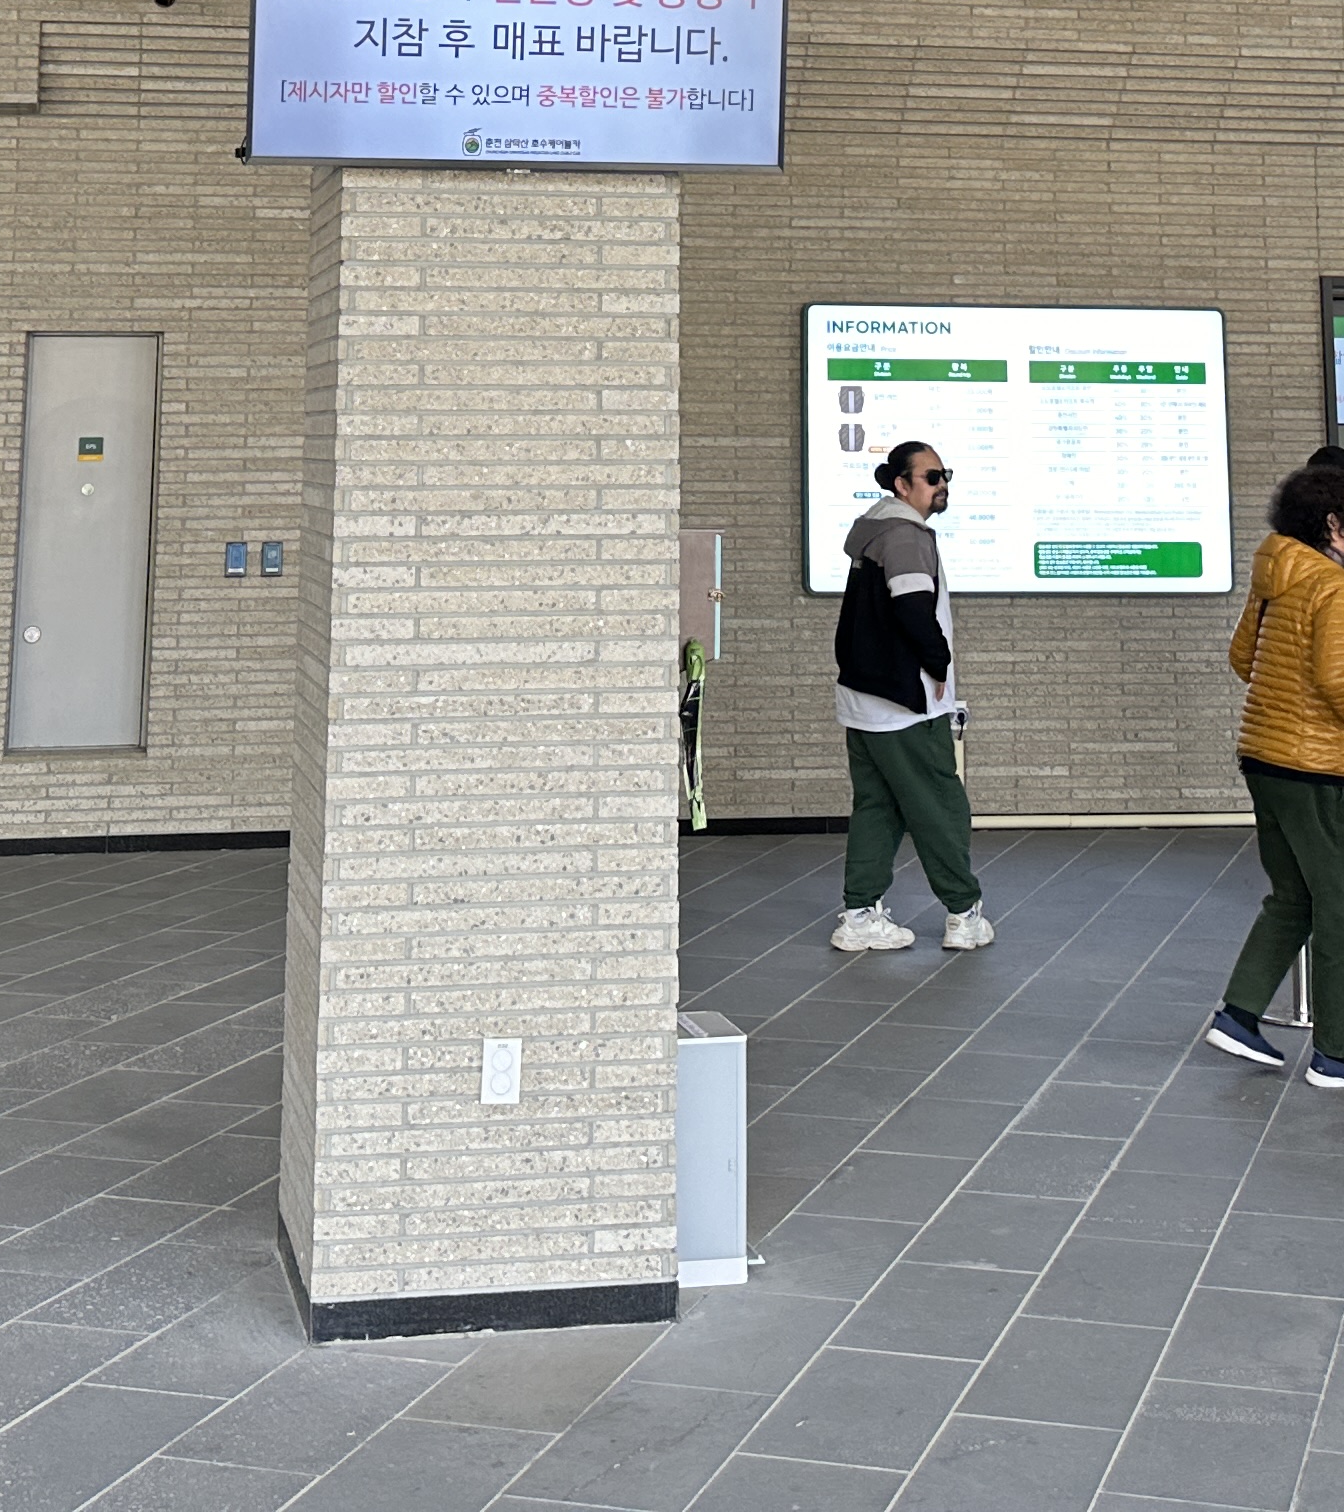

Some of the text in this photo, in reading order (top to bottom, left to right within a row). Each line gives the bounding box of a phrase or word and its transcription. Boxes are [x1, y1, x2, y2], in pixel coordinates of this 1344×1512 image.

[354, 17, 728, 65] 지참 후 매표 바랍니다.
[281, 80, 754, 112] [제시자만 할인할 수 있으며 중복할인은 불가합니다]
[826, 320, 952, 335] INFORMATION
